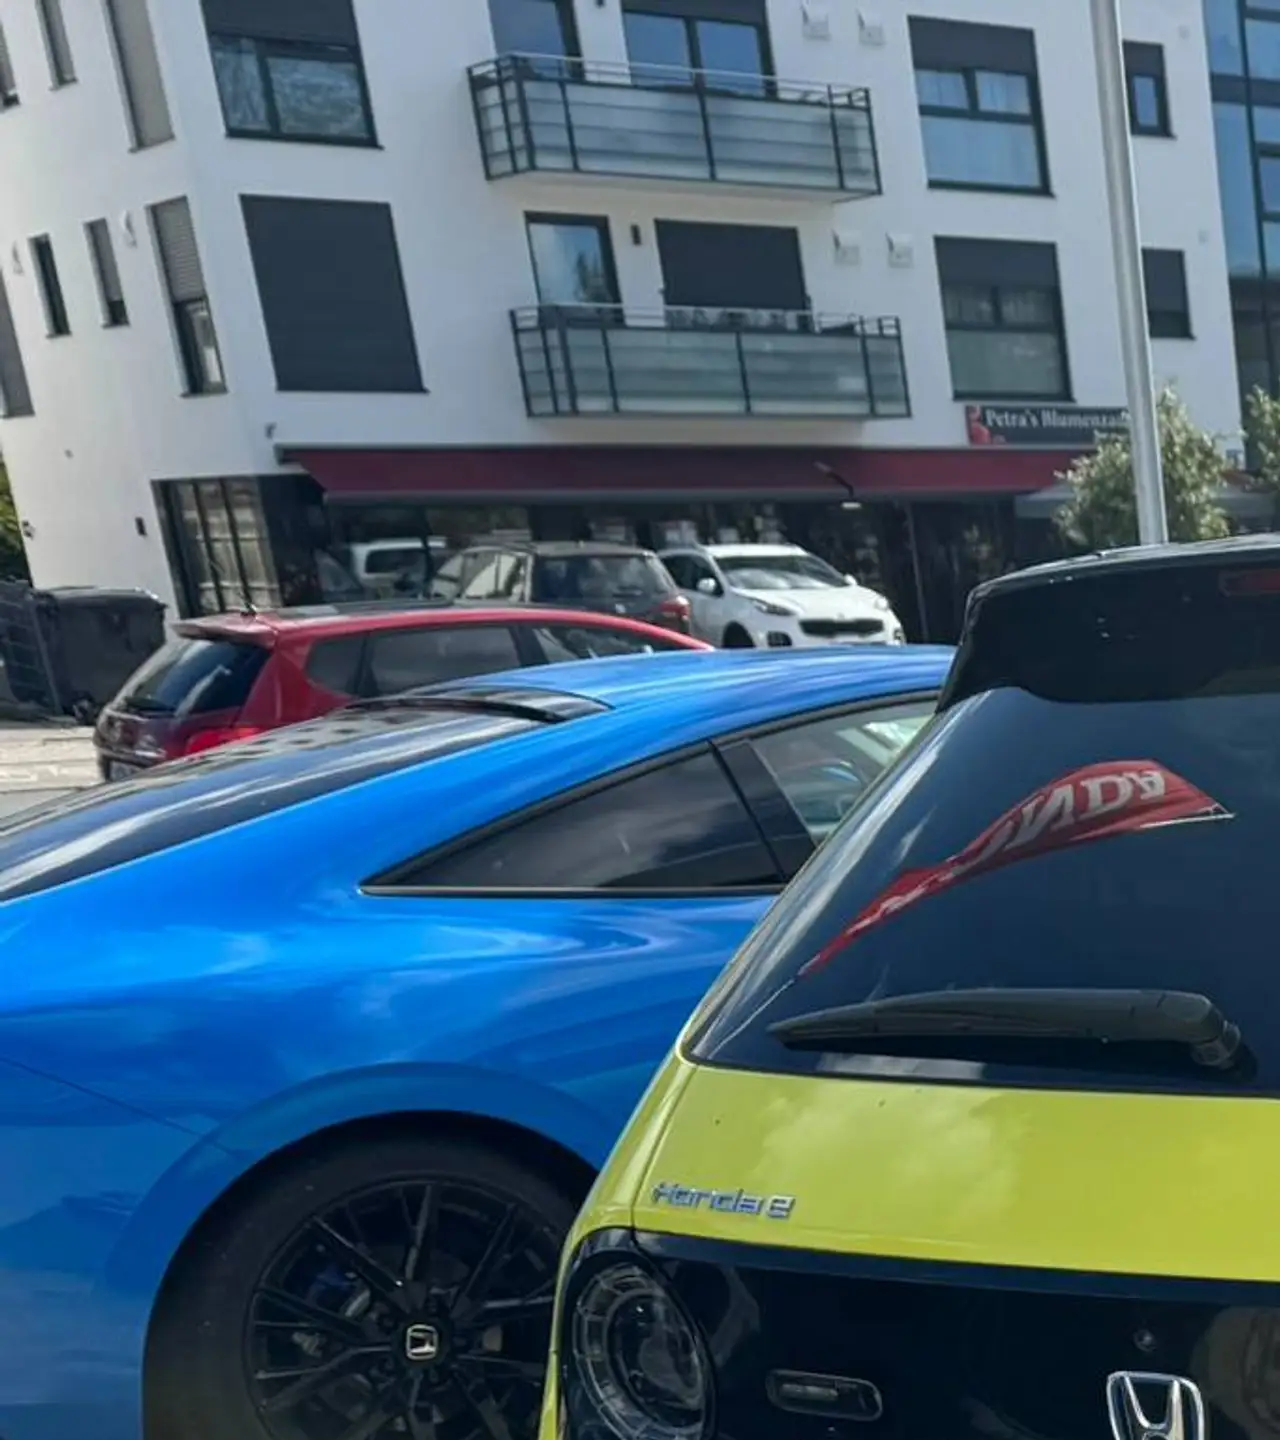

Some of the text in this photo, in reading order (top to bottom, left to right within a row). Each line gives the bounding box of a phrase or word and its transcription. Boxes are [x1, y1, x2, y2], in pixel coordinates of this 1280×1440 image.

[984, 408, 1037, 428] Petra's
[652, 1181, 797, 1219] Honda e
